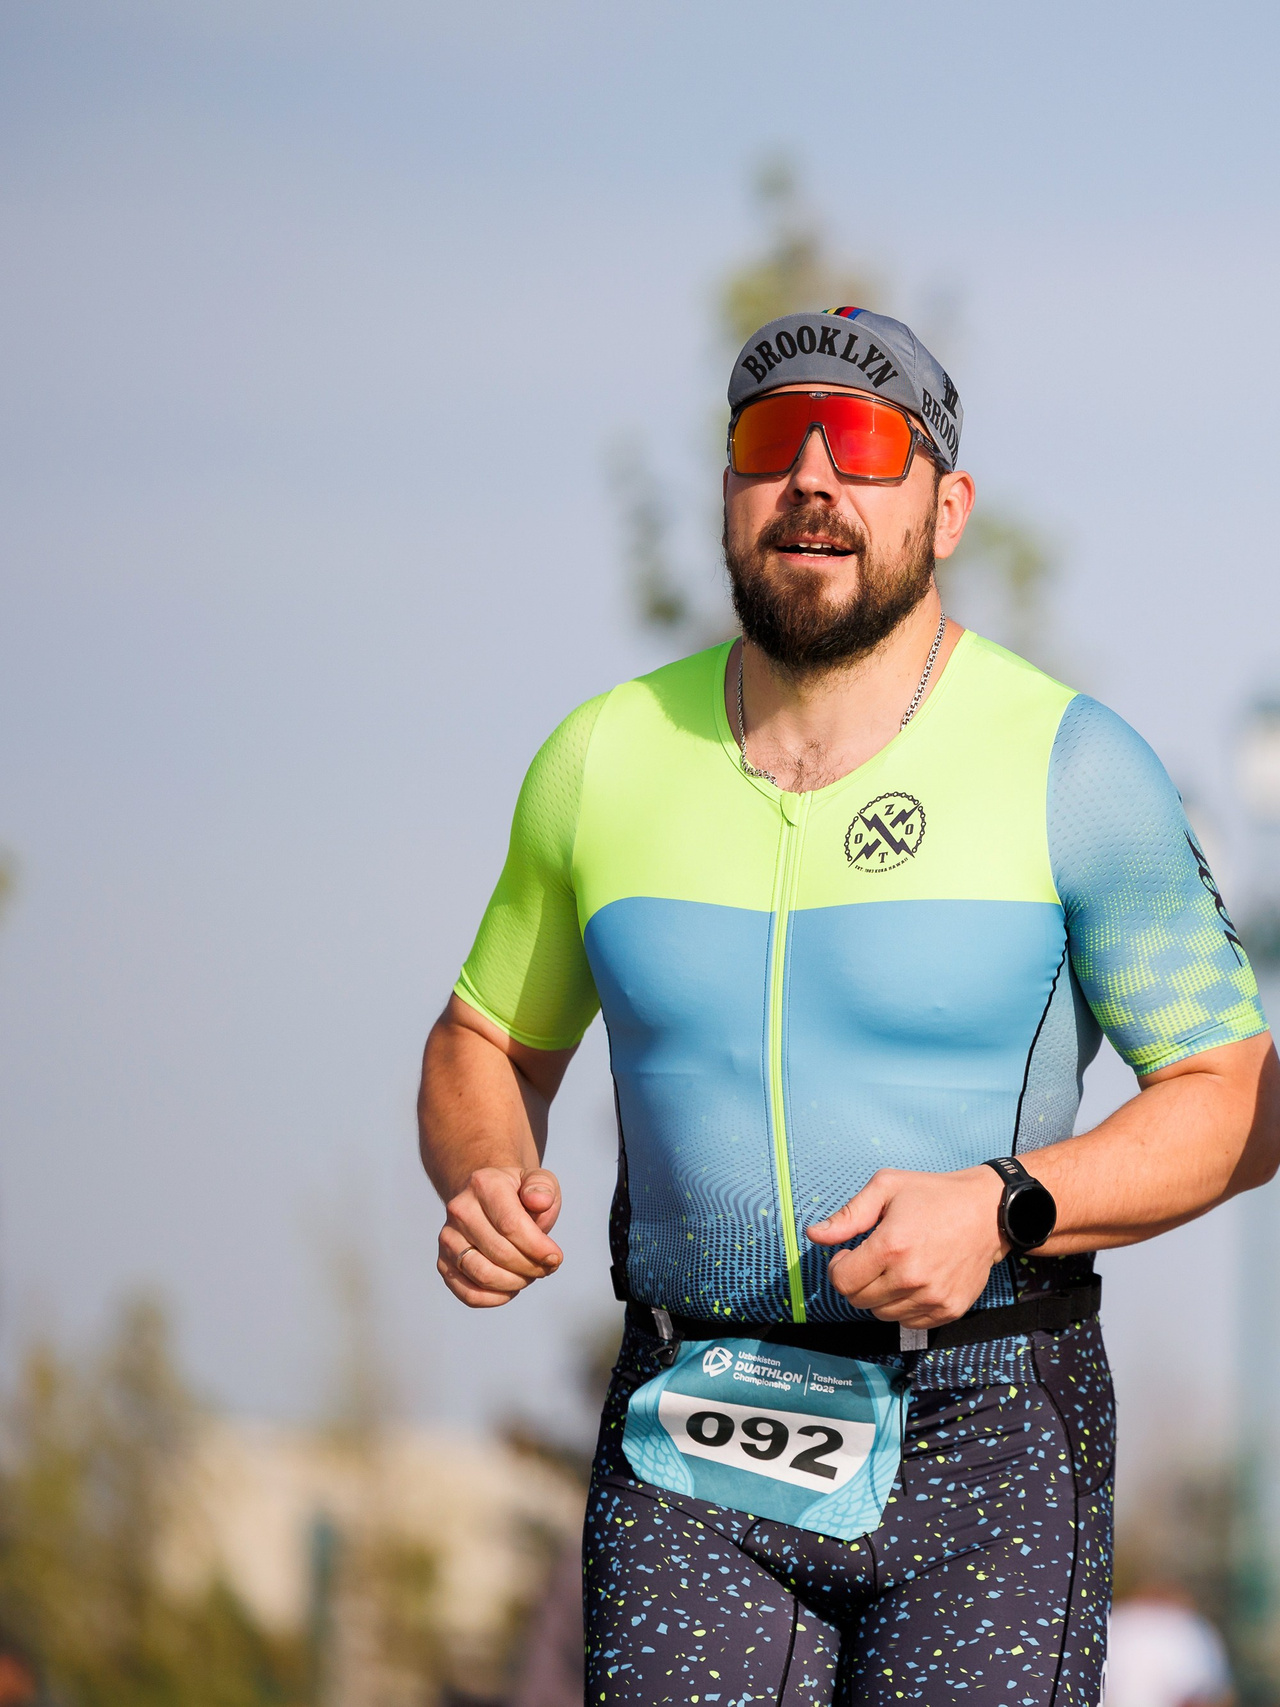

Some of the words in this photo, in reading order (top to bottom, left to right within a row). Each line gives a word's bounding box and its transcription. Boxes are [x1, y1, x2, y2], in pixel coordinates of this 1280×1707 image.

[741, 325, 899, 389] BROOKLYN
[738, 1350, 781, 1367] Uzbekistan
[732, 1371, 792, 1391] Championship
[734, 1360, 803, 1384] DUATHLON
[812, 1372, 853, 1386] Tashkent
[809, 1382, 835, 1394] 2025
[685, 1411, 844, 1480] 092
